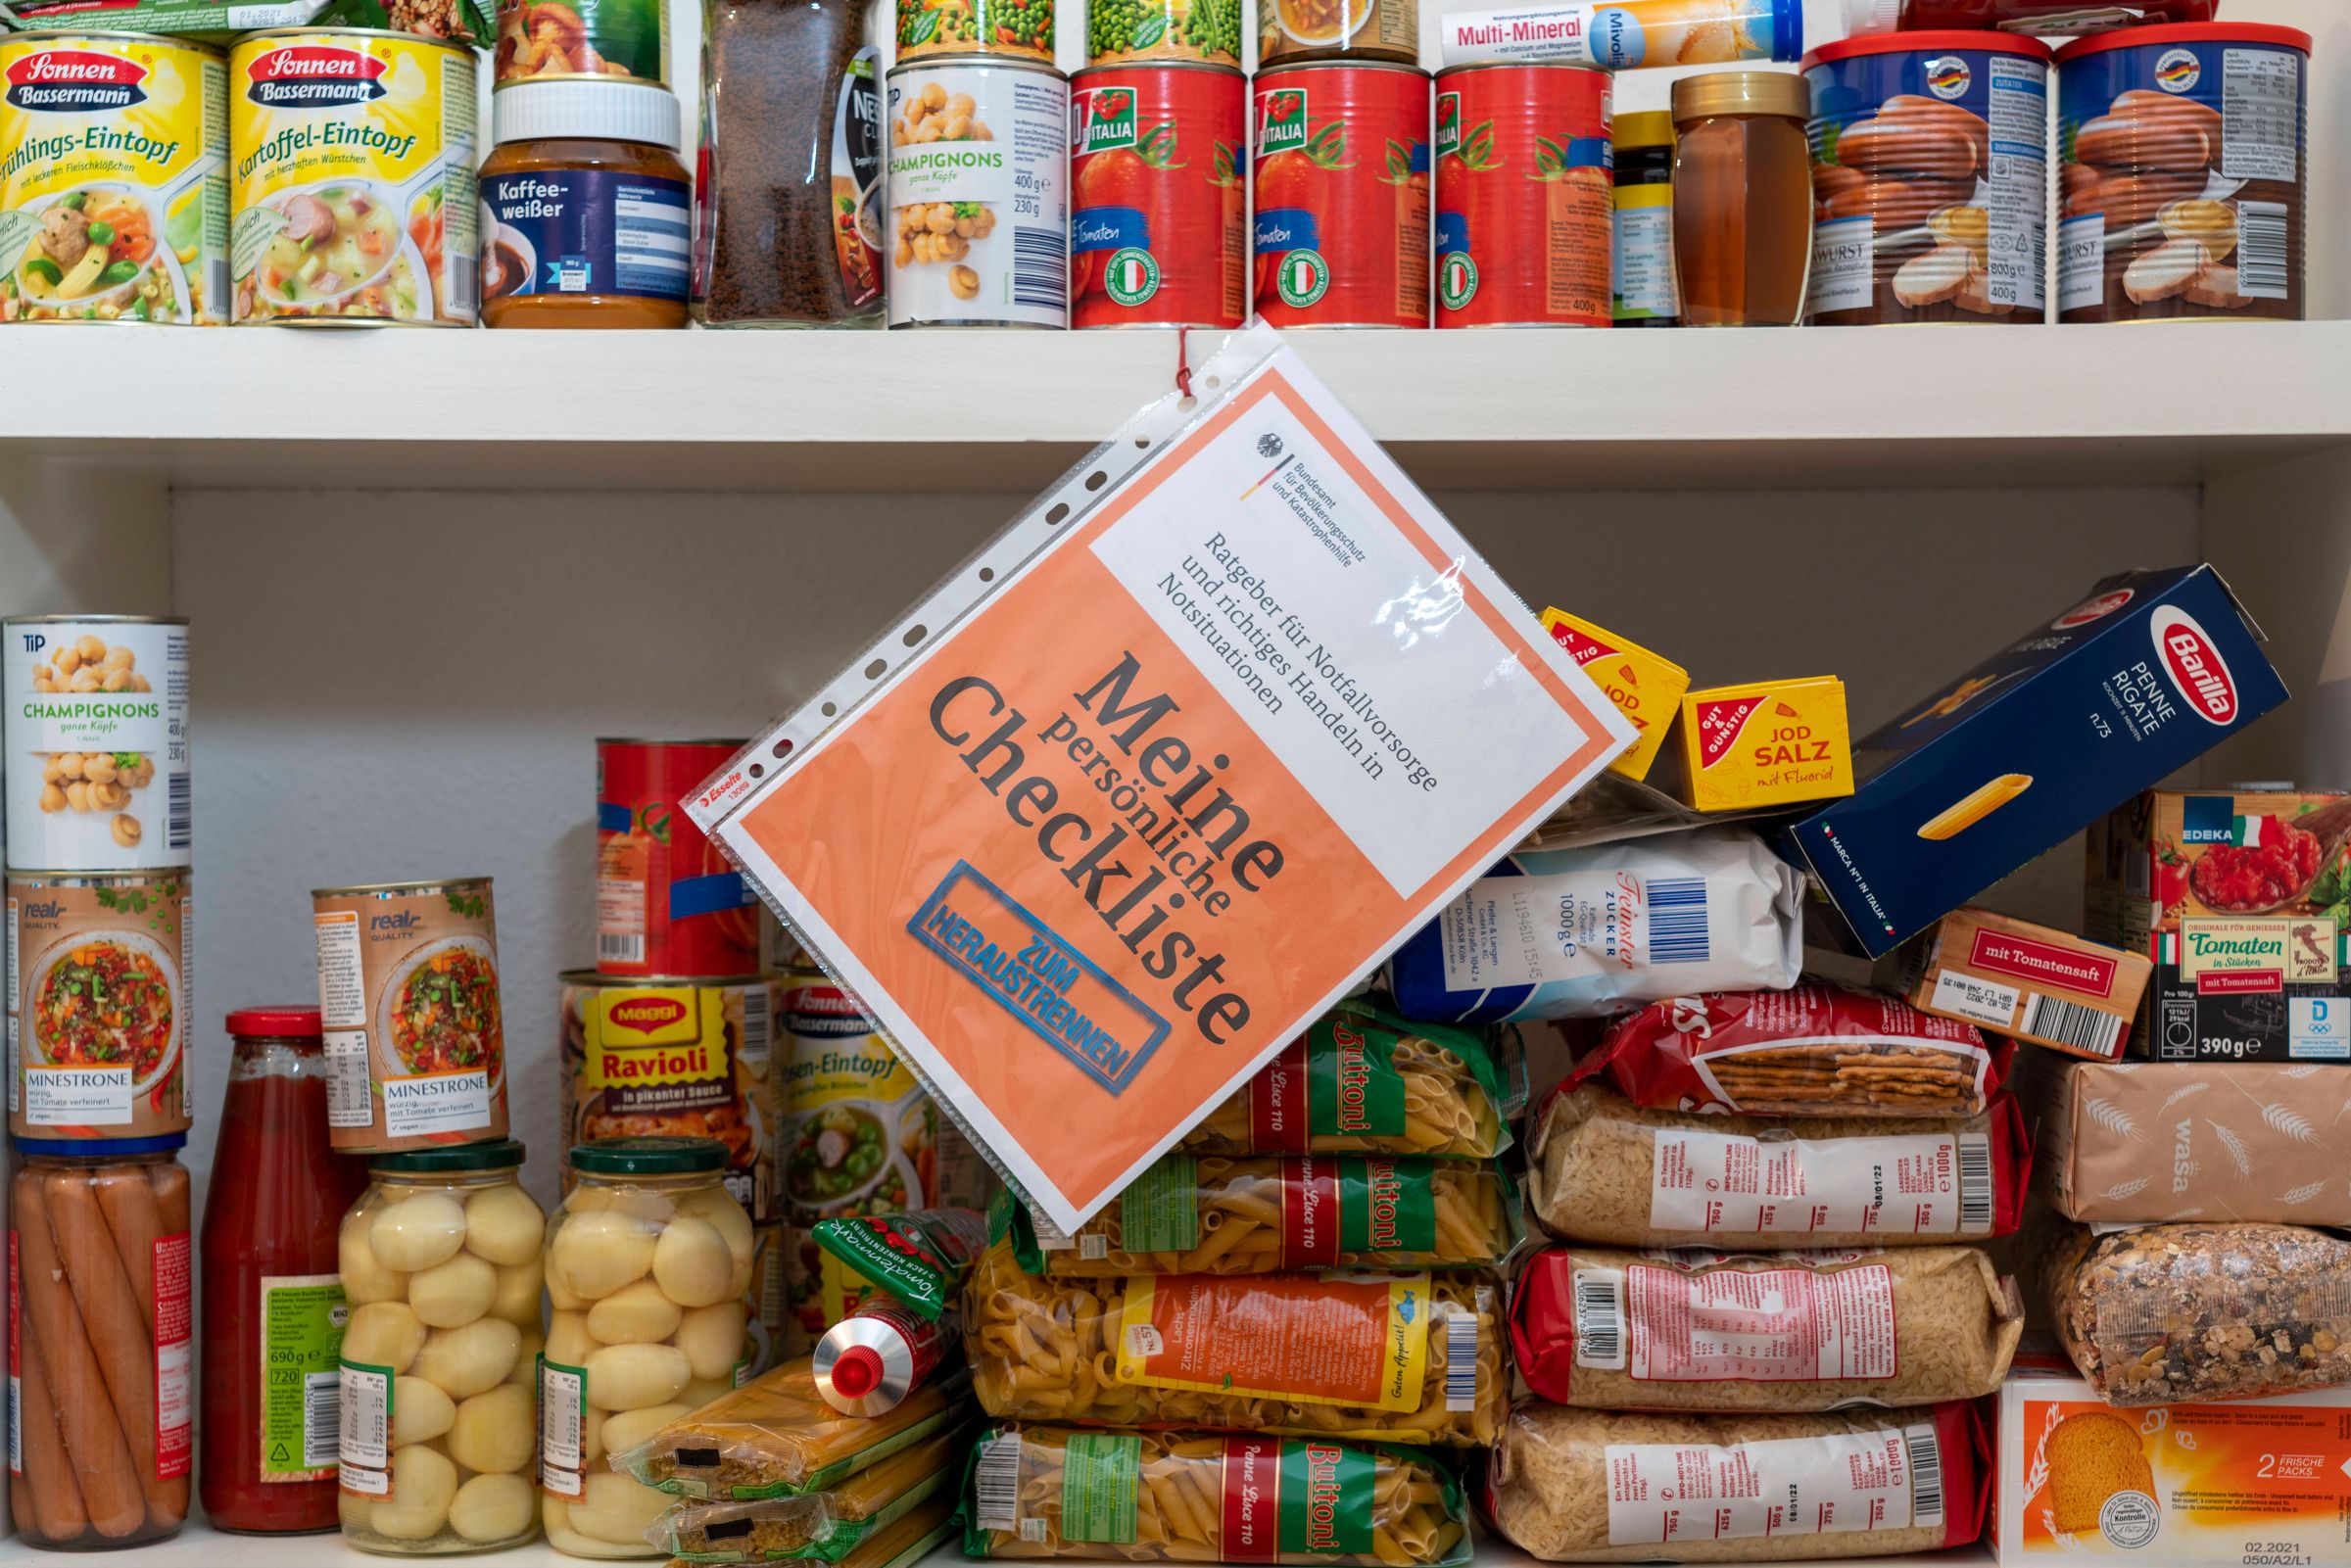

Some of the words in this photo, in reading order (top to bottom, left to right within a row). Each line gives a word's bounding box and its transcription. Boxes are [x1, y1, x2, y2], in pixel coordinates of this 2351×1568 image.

[1458, 18, 1582, 47] Multi-Mineral
[25, 53, 116, 80] Sonnen
[267, 51, 357, 78] Sonnen
[18, 84, 131, 106] Bassermann
[259, 82, 372, 104] Bassermann
[0, 125, 180, 182] rühlings-Eintopf
[237, 121, 417, 184] Kartoffel-Eintopf
[498, 180, 568, 202] Kaffee-
[1014, 174, 1033, 190] 400
[502, 200, 564, 220] weißer
[1014, 199, 1033, 214] 230
[1293, 462, 1338, 511] Bundesamt
[1271, 482, 1289, 501] und
[1286, 496, 1353, 568] Katastrophenhilfe
[1282, 470, 1299, 488] für
[1293, 482, 1367, 563] Bevölkerungsschutz
[24, 635, 46, 652] TiP
[1156, 572, 1284, 715] Notsituationen
[1180, 554, 1221, 597] und
[1215, 594, 1293, 676] richtiges
[1287, 670, 1367, 758] Handeln
[1360, 752, 1385, 782] in
[1203, 532, 1283, 619] Ratgeber
[1277, 613, 1313, 650] für
[1305, 644, 1438, 793] Notfallvorsorge
[2167, 632, 2231, 715] Barilla
[2112, 670, 2161, 736] RIGATE
[2130, 660, 2177, 723] PENNE
[24, 703, 160, 719] CHAMPIGNONS
[1702, 705, 1724, 731] GUT
[61, 721, 88, 735] ganze
[88, 719, 119, 734] Köpfe
[168, 723, 180, 736] 400
[1708, 703, 1750, 754] GÜNSTIG
[1714, 719, 1726, 730] &
[1769, 725, 1812, 743] JOD
[168, 748, 181, 762] 230
[1753, 740, 1832, 768] SALZ
[1073, 648, 1285, 893] Meine
[1757, 774, 1783, 788] mit
[1783, 766, 1834, 785] Fluorid
[707, 772, 743, 803] Esselte
[727, 780, 750, 801] 13089
[1036, 711, 1231, 918] persönliche
[2183, 829, 2233, 841] EDEKA
[929, 676, 1251, 1046] Checkliste
[1830, 836, 1852, 869] MARCA
[1858, 881, 1869, 893] IN
[1487, 900, 1497, 927] Pfeifer
[1559, 892, 1575, 928] 1000
[1616, 872, 1642, 971] Feinster
[1455, 907, 1465, 944] D-50858
[1558, 930, 1573, 941] g
[1606, 891, 1616, 957] ZUCKER
[2187, 924, 2229, 932] ORIGINALE
[2230, 923, 2242, 932] FÜR
[2243, 924, 2286, 932] GENIESSER
[1467, 927, 1478, 954] Straße
[1487, 935, 1499, 966] Langen
[2187, 931, 2282, 958] Tomaten
[1017, 934, 1081, 994] ZUM
[1458, 944, 1467, 964] Köln
[1469, 955, 1479, 975] 1042
[1985, 944, 2010, 961] mit
[2012, 949, 2100, 983] Tomatensaft
[2213, 957, 2224, 969] in
[2224, 956, 2263, 969] Stücken
[927, 904, 1132, 1075] HERAUSTRENNEN
[2204, 979, 2220, 988] mit
[2220, 975, 2277, 987] Tomatensaft
[617, 1005, 678, 1022] Maggi
[1965, 992, 2012, 1012] 28.02.2022
[2200, 1037, 2233, 1054] 390
[2233, 1040, 2244, 1058] g
[601, 1048, 709, 1080] Ravioli
[28, 1071, 128, 1088] MINESTRONE
[388, 1075, 486, 1099] MINESTRONE
[1332, 1021, 1371, 1132] Buitoni
[29, 1097, 39, 1107] mit
[40, 1097, 69, 1107] Tomate
[69, 1097, 111, 1107] verfeinert
[635, 1086, 686, 1105] pikanter
[688, 1084, 723, 1099] Sauce
[404, 1106, 437, 1117] Tomate
[438, 1101, 474, 1113] verfeinert
[1937, 1144, 1951, 1179] 1000g
[1366, 1158, 1403, 1249] uitoni
[1710, 1209, 1721, 1226] 750
[1763, 1212, 1773, 1226] 625
[1816, 1212, 1826, 1226] 500
[1867, 1211, 1878, 1226] 375
[1920, 1211, 1930, 1226] 250
[848, 1220, 906, 1263] KONZENTRIERT
[831, 1218, 936, 1302] Tomatenmark
[333, 1308, 349, 1318] BIO
[1393, 1324, 1411, 1367] Appetit!
[270, 1352, 294, 1363] 690
[296, 1354, 305, 1365] g
[273, 1371, 298, 1383] 720
[1391, 1369, 1405, 1399] Guten
[1886, 1438, 1902, 1473] 1000g
[2257, 1453, 2276, 1479] 2
[2279, 1457, 2326, 1467] FRISCHE
[1675, 1451, 1686, 1499] INFO-HOTLINE
[2278, 1467, 2314, 1477] PACKS
[1241, 1483, 1260, 1522] Lisce
[1305, 1442, 1344, 1549] Buitoni
[1720, 1514, 1730, 1532] 625
[1824, 1509, 1833, 1525] 375
[1875, 1505, 1884, 1521] 250
[2114, 1513, 2147, 1522] Kontrolle
[1240, 1523, 1254, 1545] 110
[1669, 1517, 1678, 1534] 750
[2244, 1542, 2300, 1553] 02.2021
[2241, 1553, 2312, 1567] 050/A2/L1
